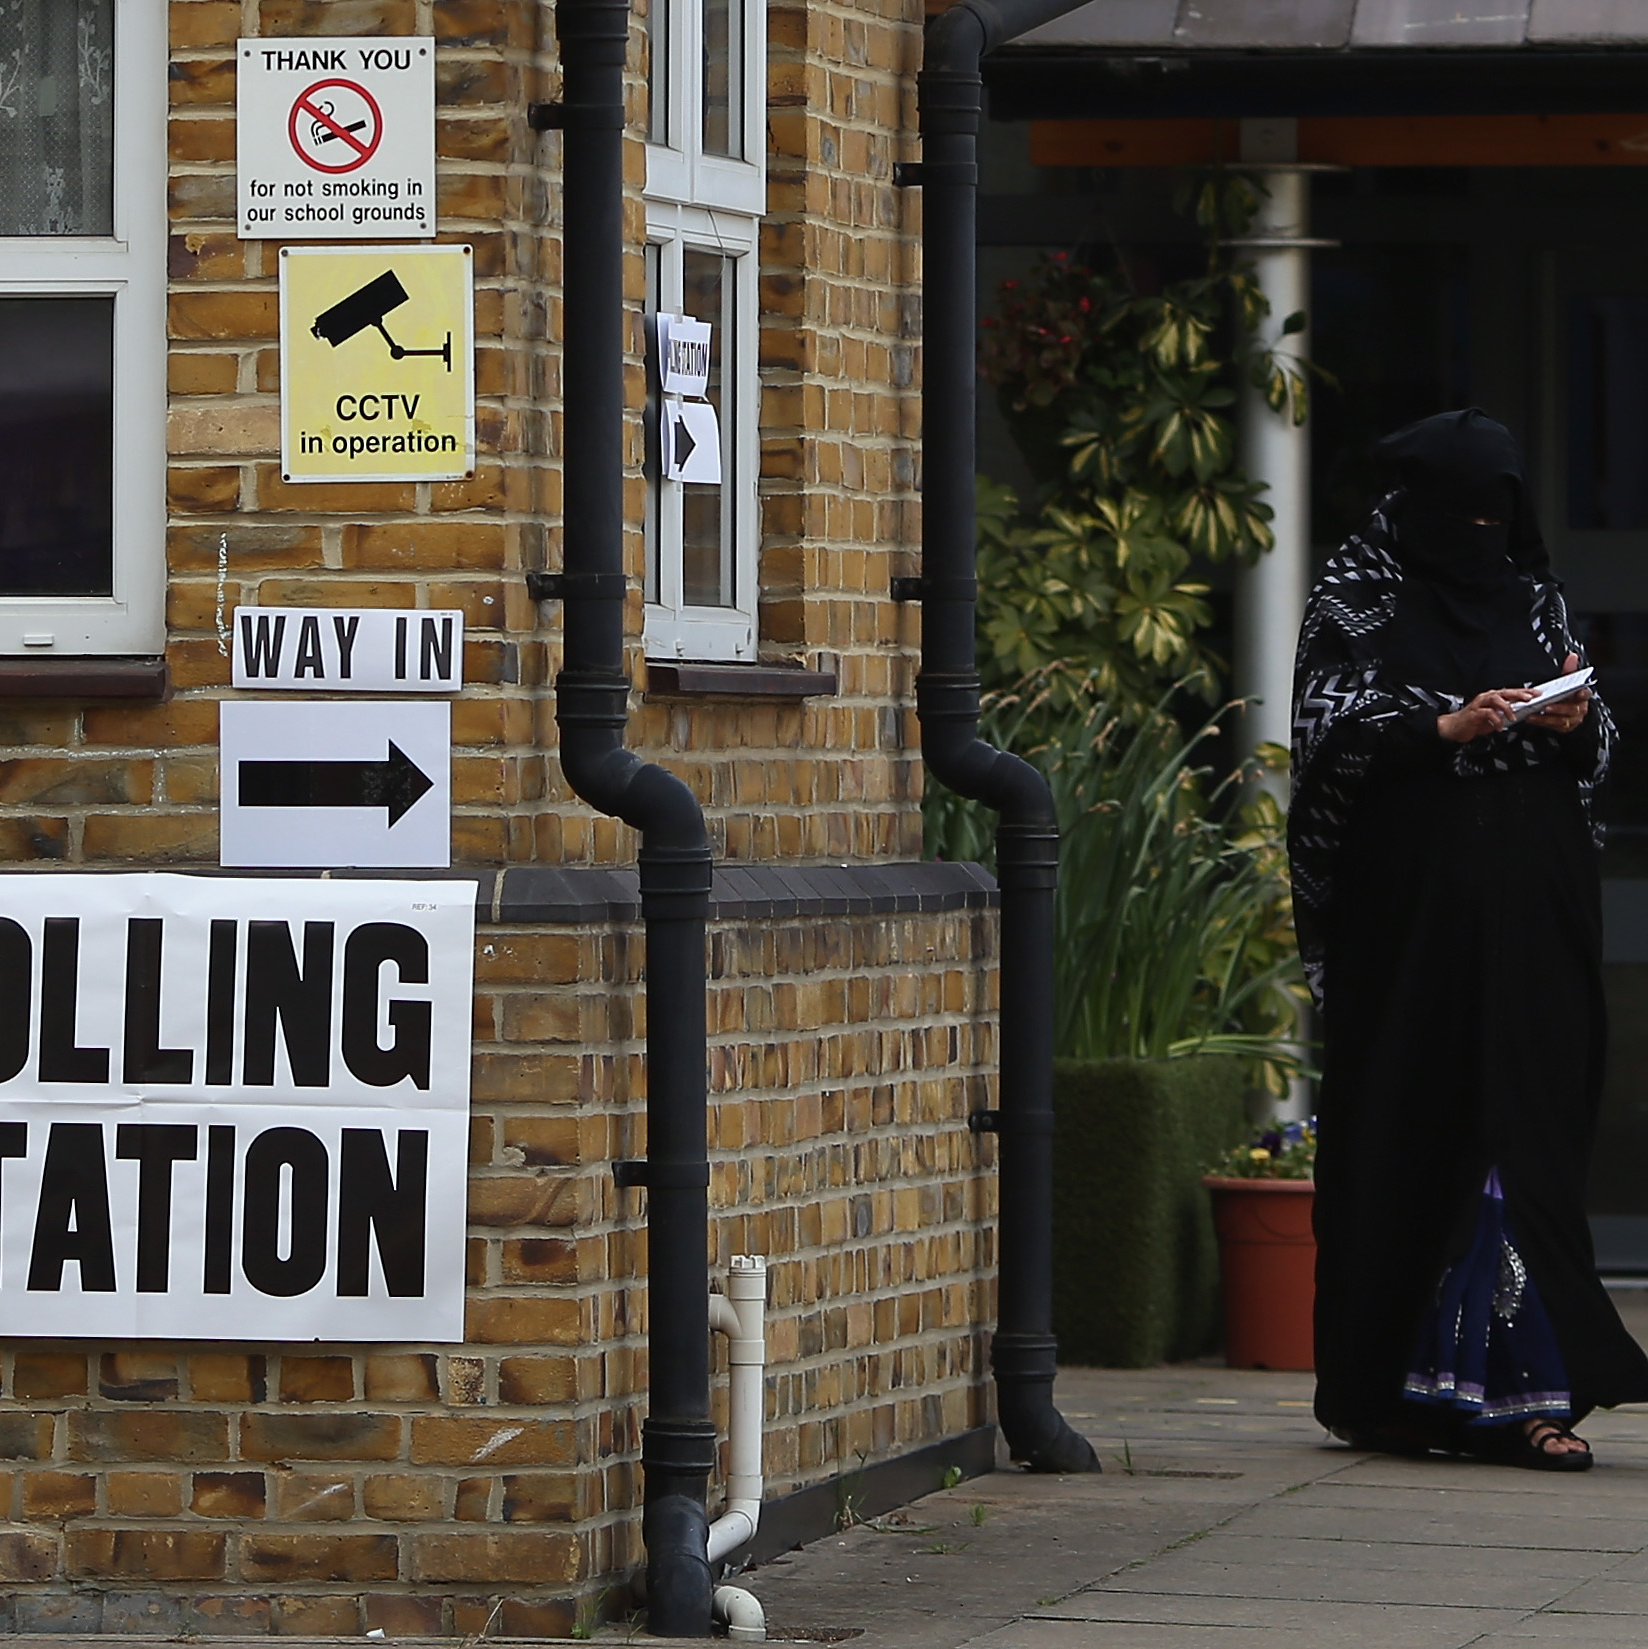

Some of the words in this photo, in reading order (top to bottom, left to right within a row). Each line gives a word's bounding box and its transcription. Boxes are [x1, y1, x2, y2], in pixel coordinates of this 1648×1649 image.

[261, 50, 347, 71] THANK
[359, 49, 411, 71] YOU
[250, 179, 276, 197] for
[284, 180, 313, 197] not
[322, 178, 399, 200] smoking
[407, 178, 423, 196] in
[247, 207, 276, 222] our
[284, 203, 345, 221] school
[352, 203, 426, 225] grounds
[336, 394, 421, 421] CCTV
[301, 431, 323, 454] in
[332, 429, 457, 460] operation
[240, 615, 360, 679] WAY
[394, 616, 454, 681] IN
